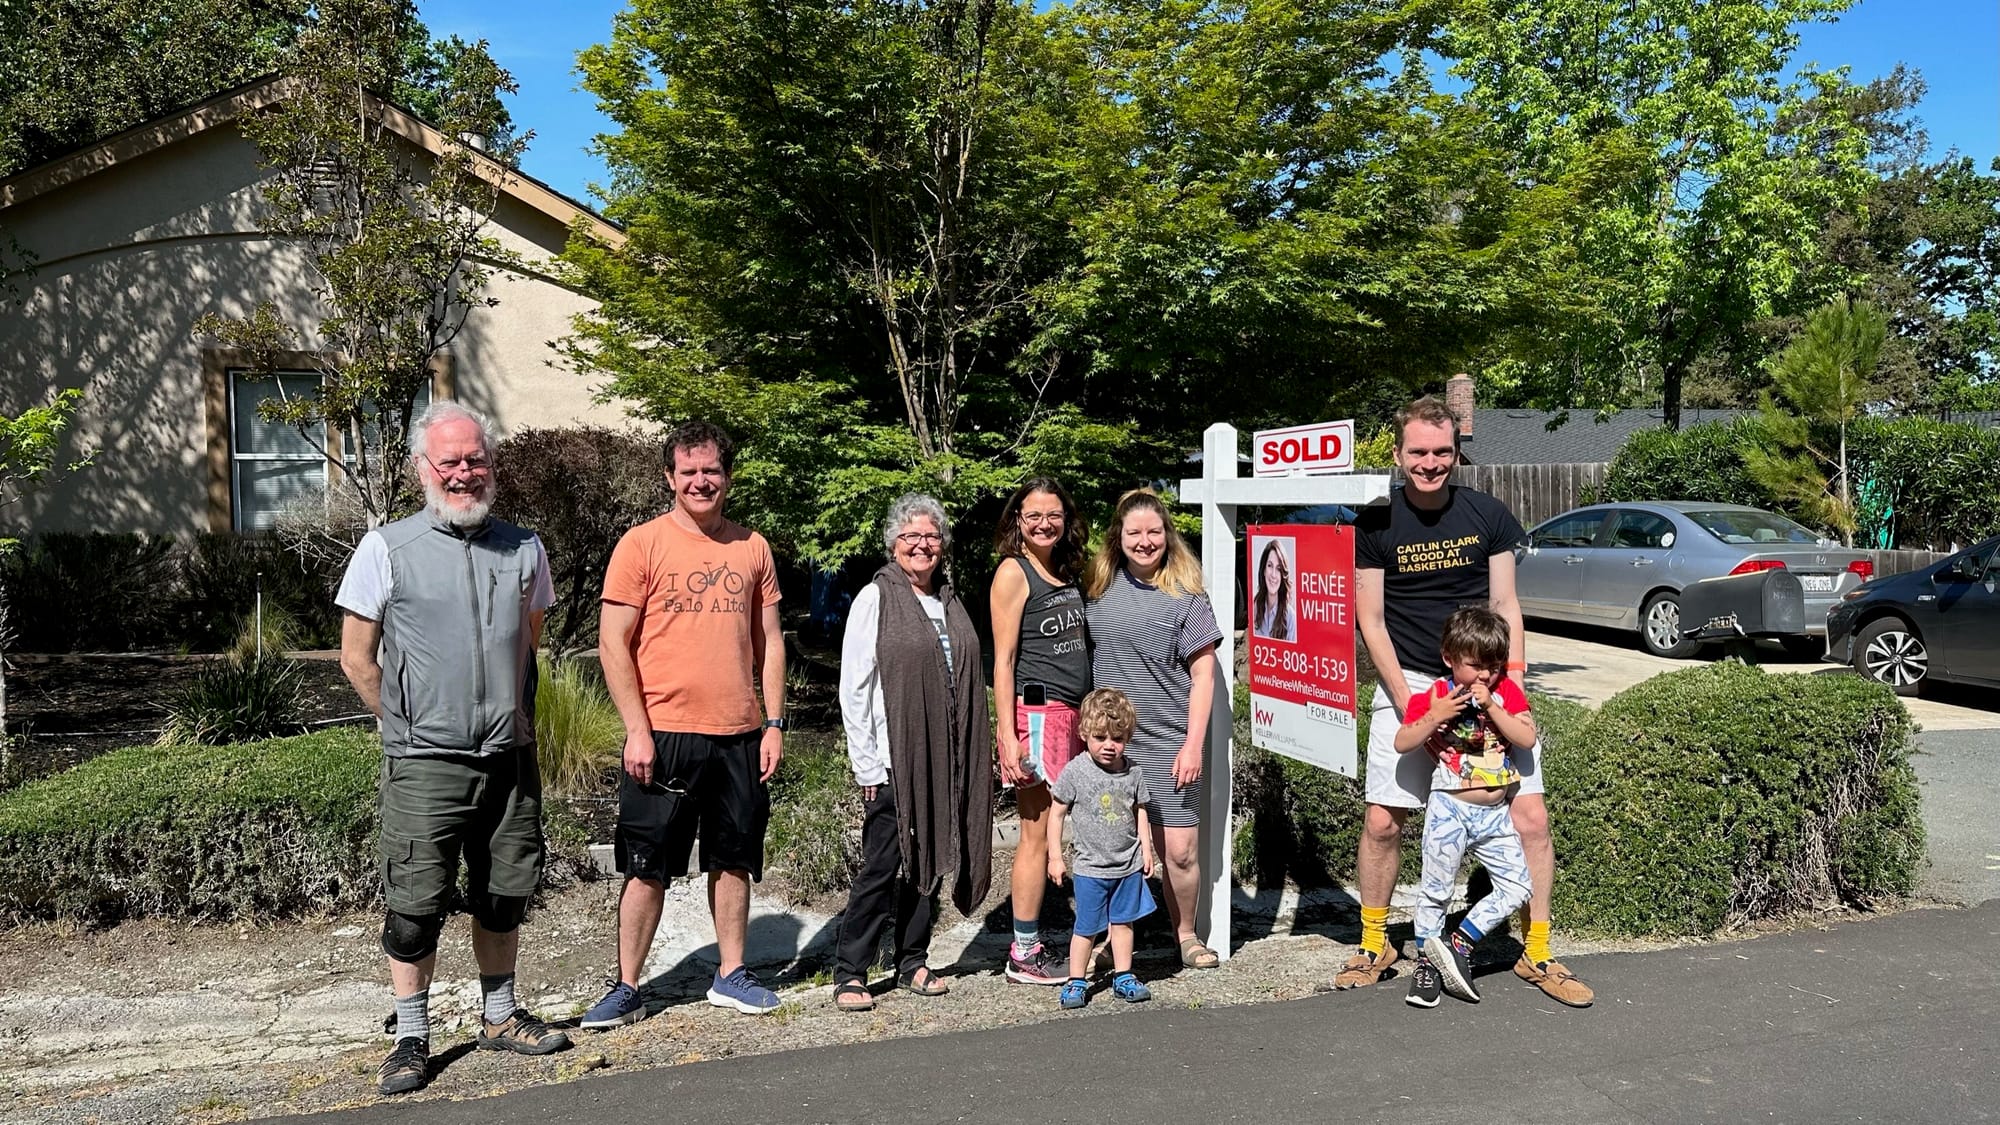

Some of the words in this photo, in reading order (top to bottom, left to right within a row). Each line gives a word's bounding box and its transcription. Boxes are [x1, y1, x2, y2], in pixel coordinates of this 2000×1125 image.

[1262, 434, 1342, 465] SOLD
[1396, 541, 1440, 555] CAITLIN
[1442, 535, 1480, 548] CLARK
[1398, 554, 1408, 564] IS
[1411, 550, 1444, 563] GOOD
[1446, 548, 1461, 559] AT
[667, 573, 679, 592] I
[1301, 571, 1346, 597] RENÉE
[662, 599, 703, 614] Palo
[710, 599, 746, 613] Alto
[1301, 599, 1346, 625] WHITE
[1254, 645, 1348, 682] 925-808-1539
[1253, 673, 1350, 705] www.ReneeWhiteTeam.com
[1310, 706, 1326, 719] FOR
[1328, 712, 1349, 726] SALE
